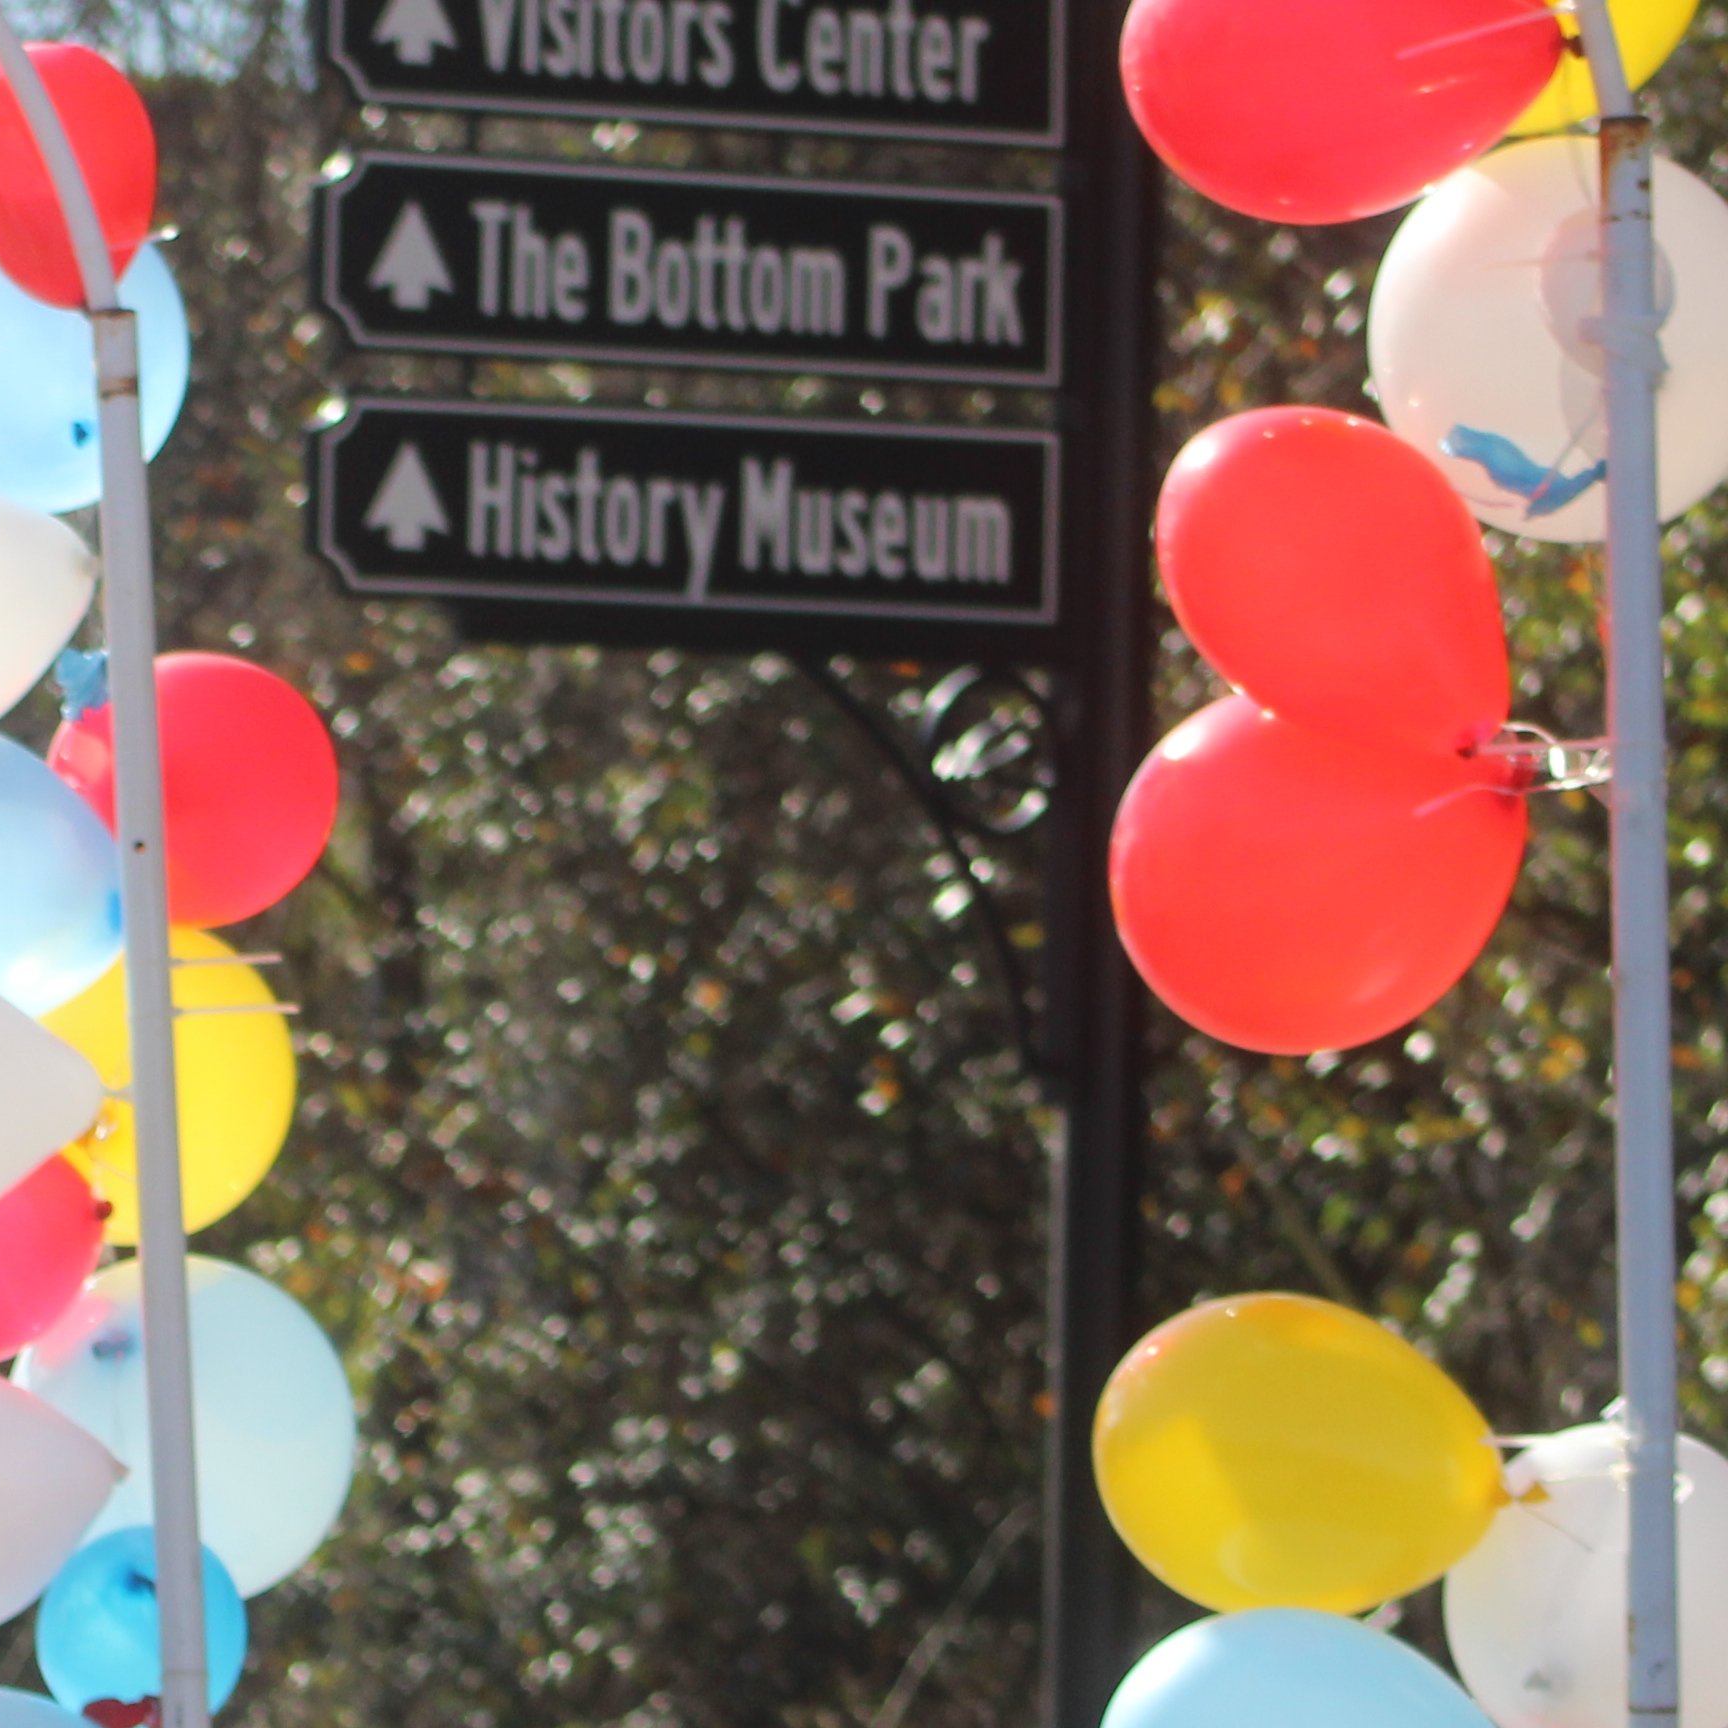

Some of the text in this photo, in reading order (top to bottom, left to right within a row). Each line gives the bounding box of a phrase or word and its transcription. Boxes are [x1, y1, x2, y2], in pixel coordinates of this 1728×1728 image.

[479, 0, 990, 102] Visitors Center
[470, 202, 1025, 347] The Bottom Park
[466, 441, 1011, 601] History Museum
